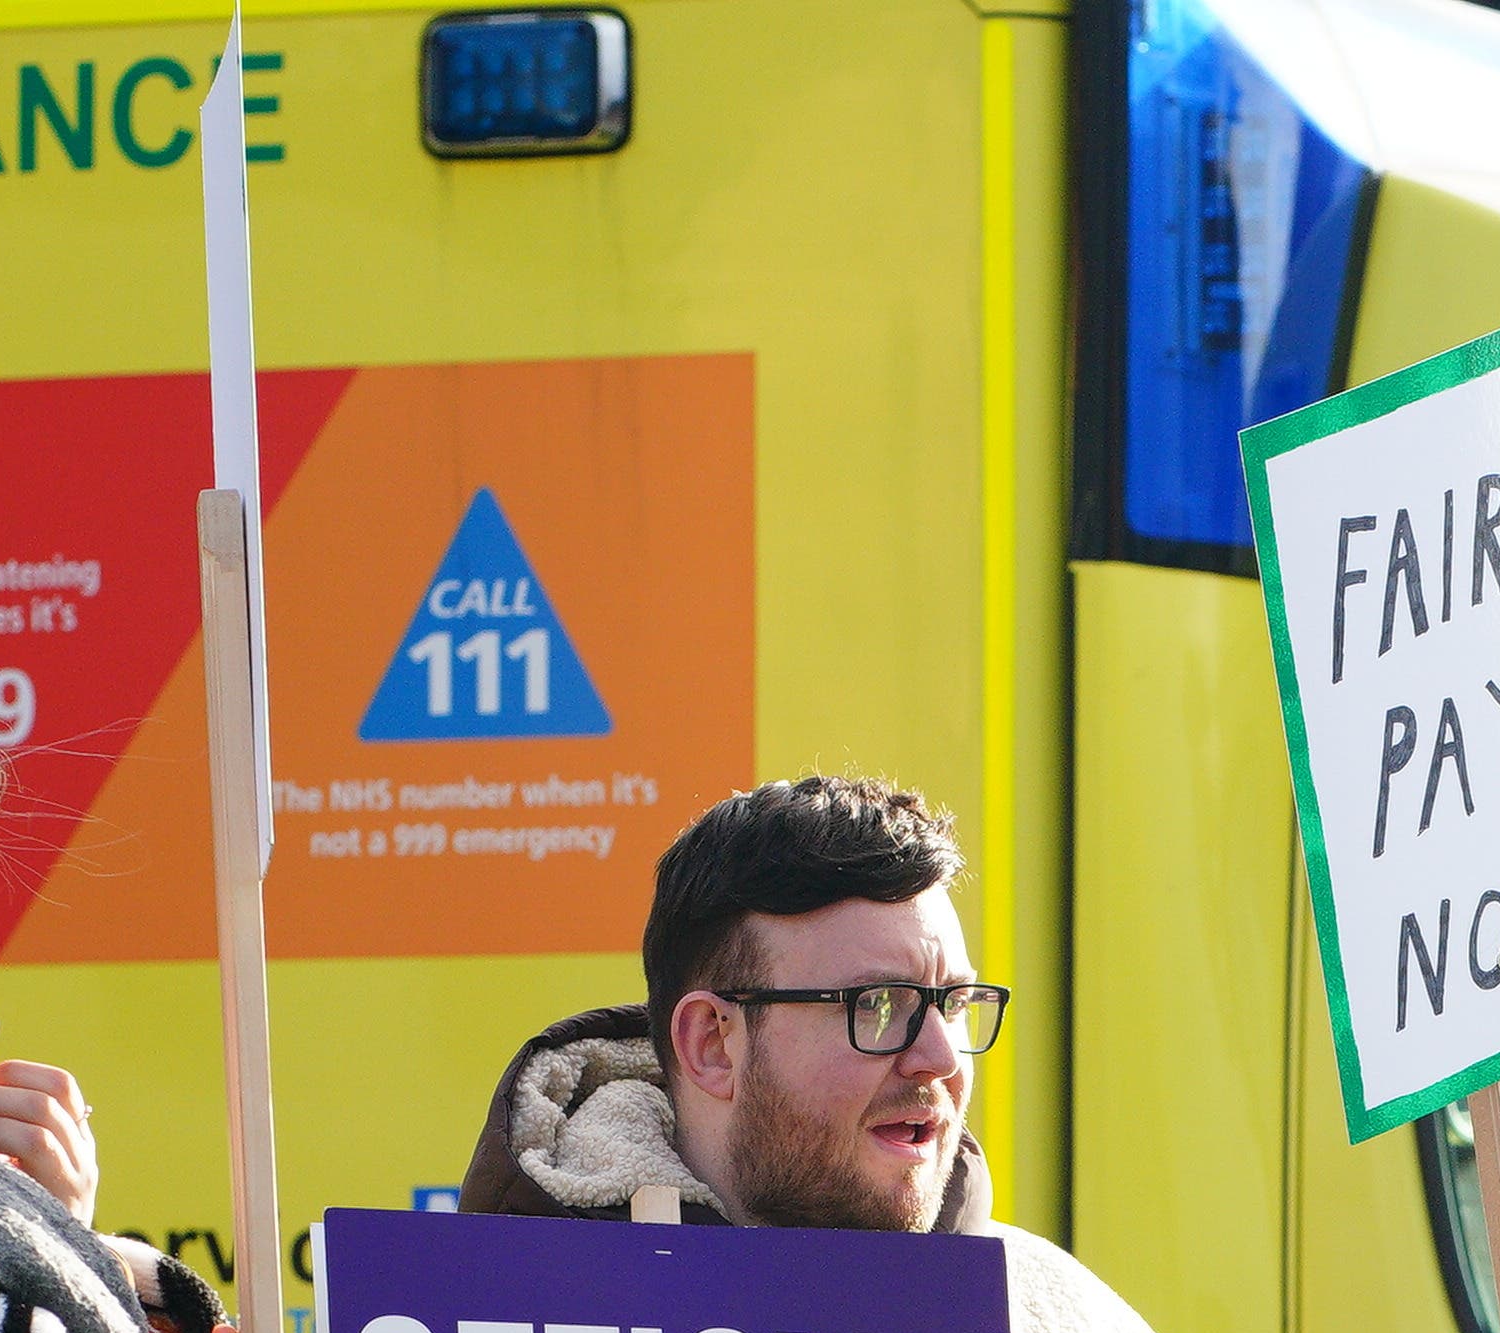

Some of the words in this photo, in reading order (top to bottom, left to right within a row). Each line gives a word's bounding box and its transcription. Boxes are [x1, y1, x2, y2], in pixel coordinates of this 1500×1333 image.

[30, 597, 78, 633] it's
[428, 577, 537, 619] CALL
[408, 628, 550, 716] 111
[273, 780, 323, 813] The
[330, 777, 392, 811] NHS
[401, 776, 514, 809] number
[522, 774, 605, 808] when
[612, 771, 658, 806] it's
[310, 827, 362, 857] not
[367, 832, 387, 857] a
[393, 823, 447, 855] 999
[452, 824, 616, 861] emergency
